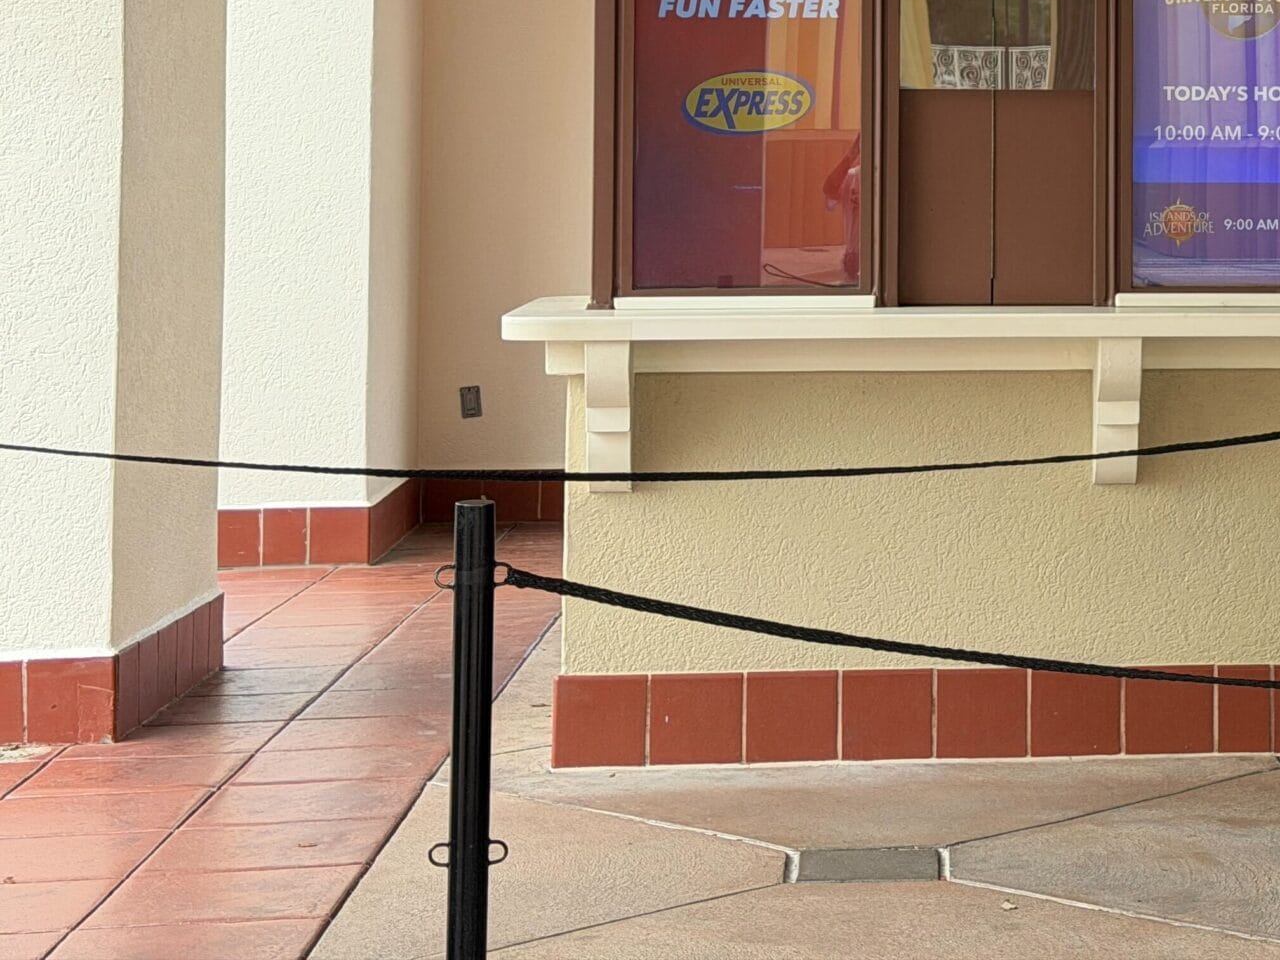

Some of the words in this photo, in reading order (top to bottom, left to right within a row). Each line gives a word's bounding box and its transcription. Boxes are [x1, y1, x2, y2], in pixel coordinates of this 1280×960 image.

[1211, 2, 1275, 15] FLORIDA
[720, 77, 784, 87] UNIVERSAL
[1162, 85, 1249, 103] TODAY'S
[693, 87, 806, 130] EXPRESS
[1153, 124, 1206, 142] 10:00
[1210, 125, 1242, 142] AM
[1149, 210, 1197, 223] ISLANDS
[1142, 220, 1216, 238] ADVENTURE
[1223, 218, 1254, 232] 9:00
[1256, 218, 1280, 231] AM
